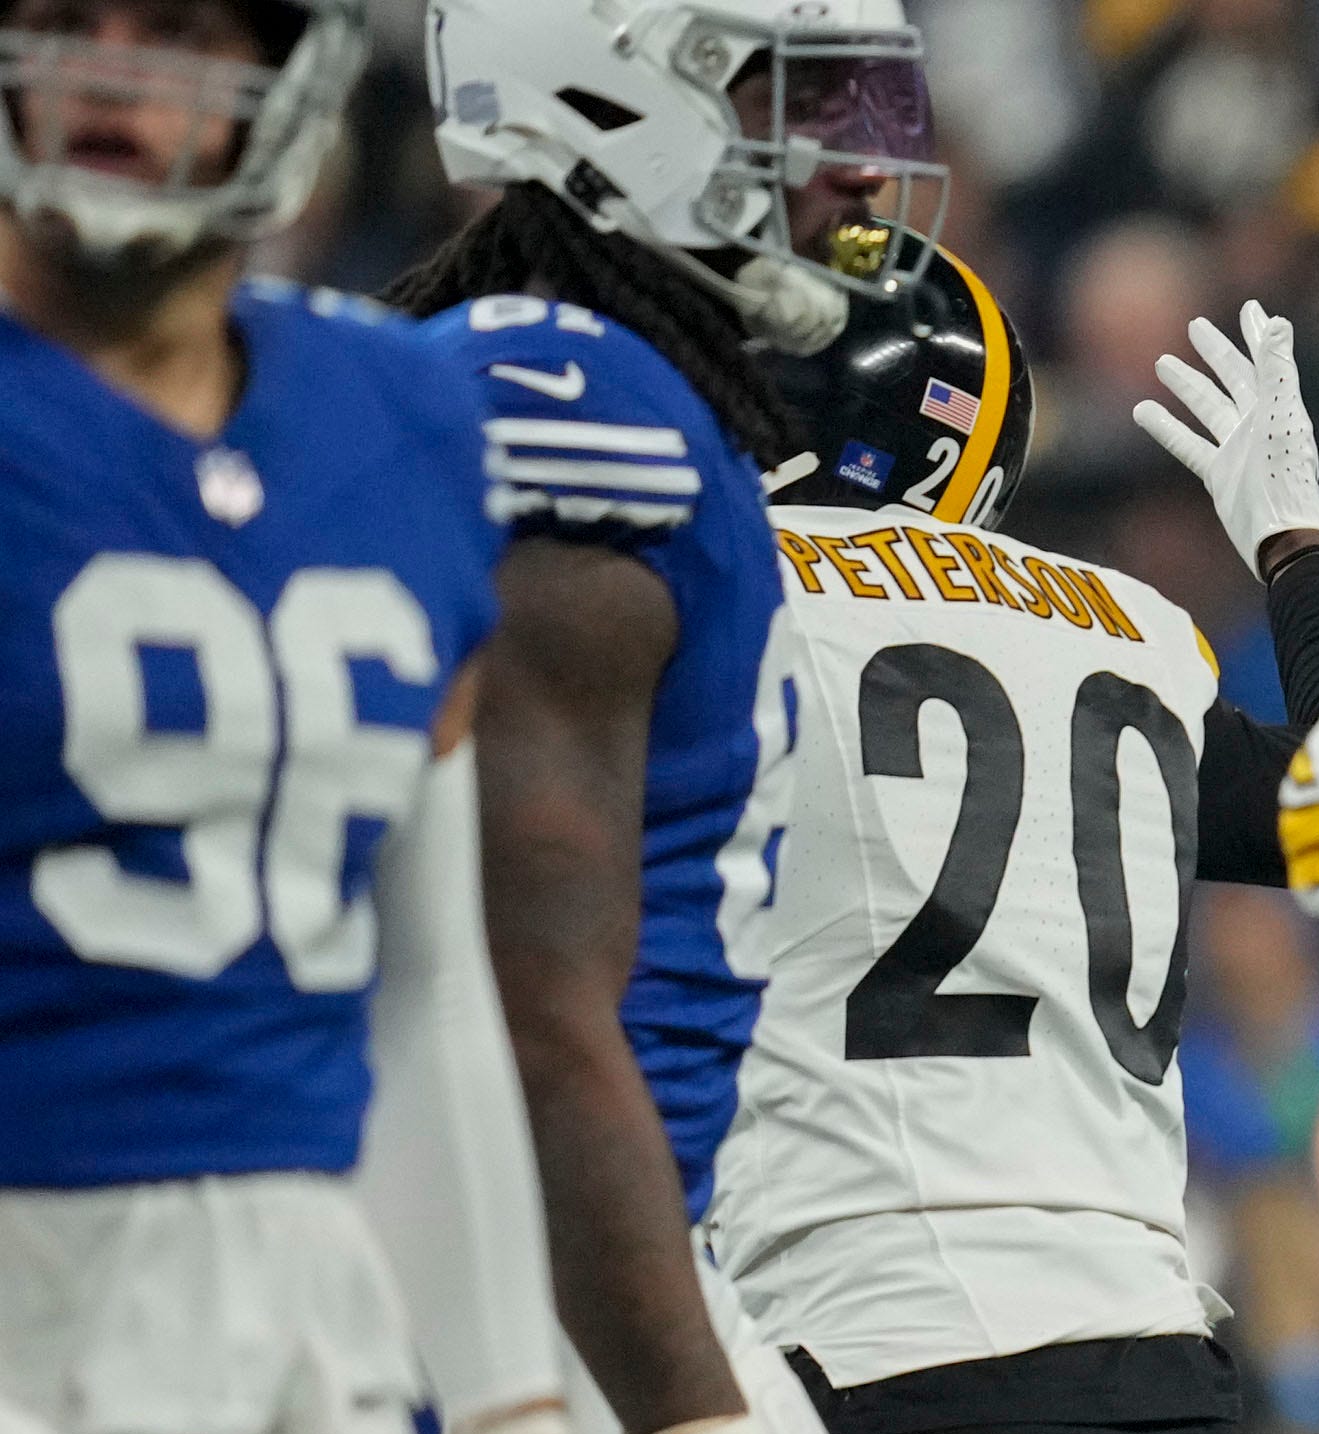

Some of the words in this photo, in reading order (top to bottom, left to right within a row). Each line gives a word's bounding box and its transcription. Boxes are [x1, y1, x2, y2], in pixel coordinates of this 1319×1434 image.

[776, 526, 1145, 642] PETERSON
[902, 436, 1004, 526] 20
[30, 550, 439, 993] 96
[845, 642, 1201, 1086] 20
